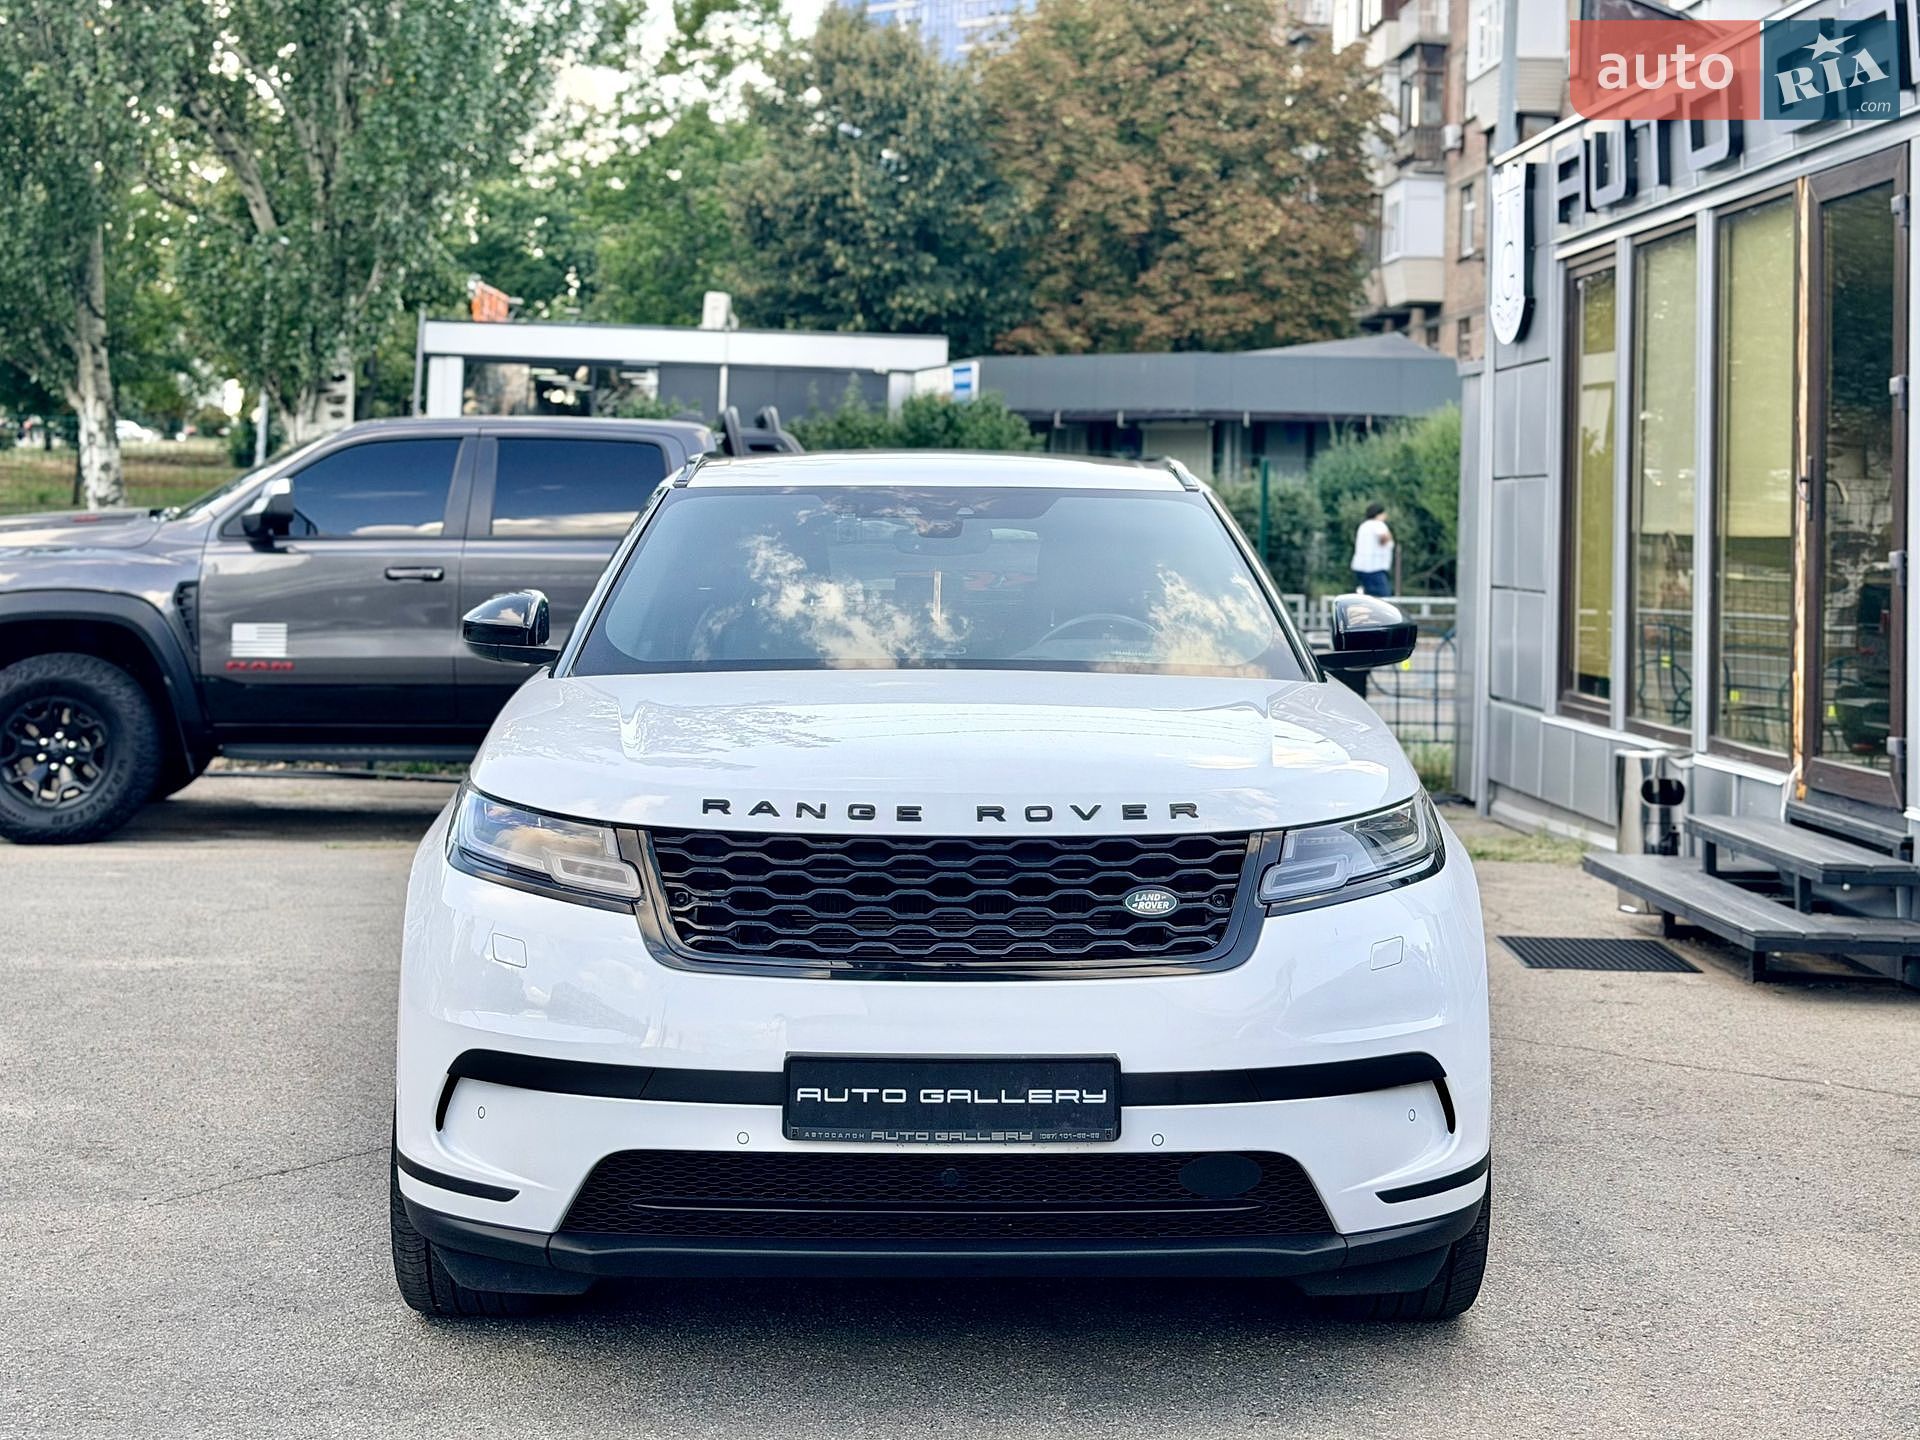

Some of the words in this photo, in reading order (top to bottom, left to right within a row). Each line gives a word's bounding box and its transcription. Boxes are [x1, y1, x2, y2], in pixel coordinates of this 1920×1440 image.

[702, 798, 922, 822] RANGE
[976, 802, 1199, 823] ROVER
[1135, 893, 1161, 902] LAND
[1137, 901, 1170, 910] ROVER
[797, 1088, 907, 1103] AUTO
[919, 1089, 1107, 1104] GALLERY
[871, 1131, 929, 1141] AUTO
[935, 1131, 1033, 1141] GALLERY
